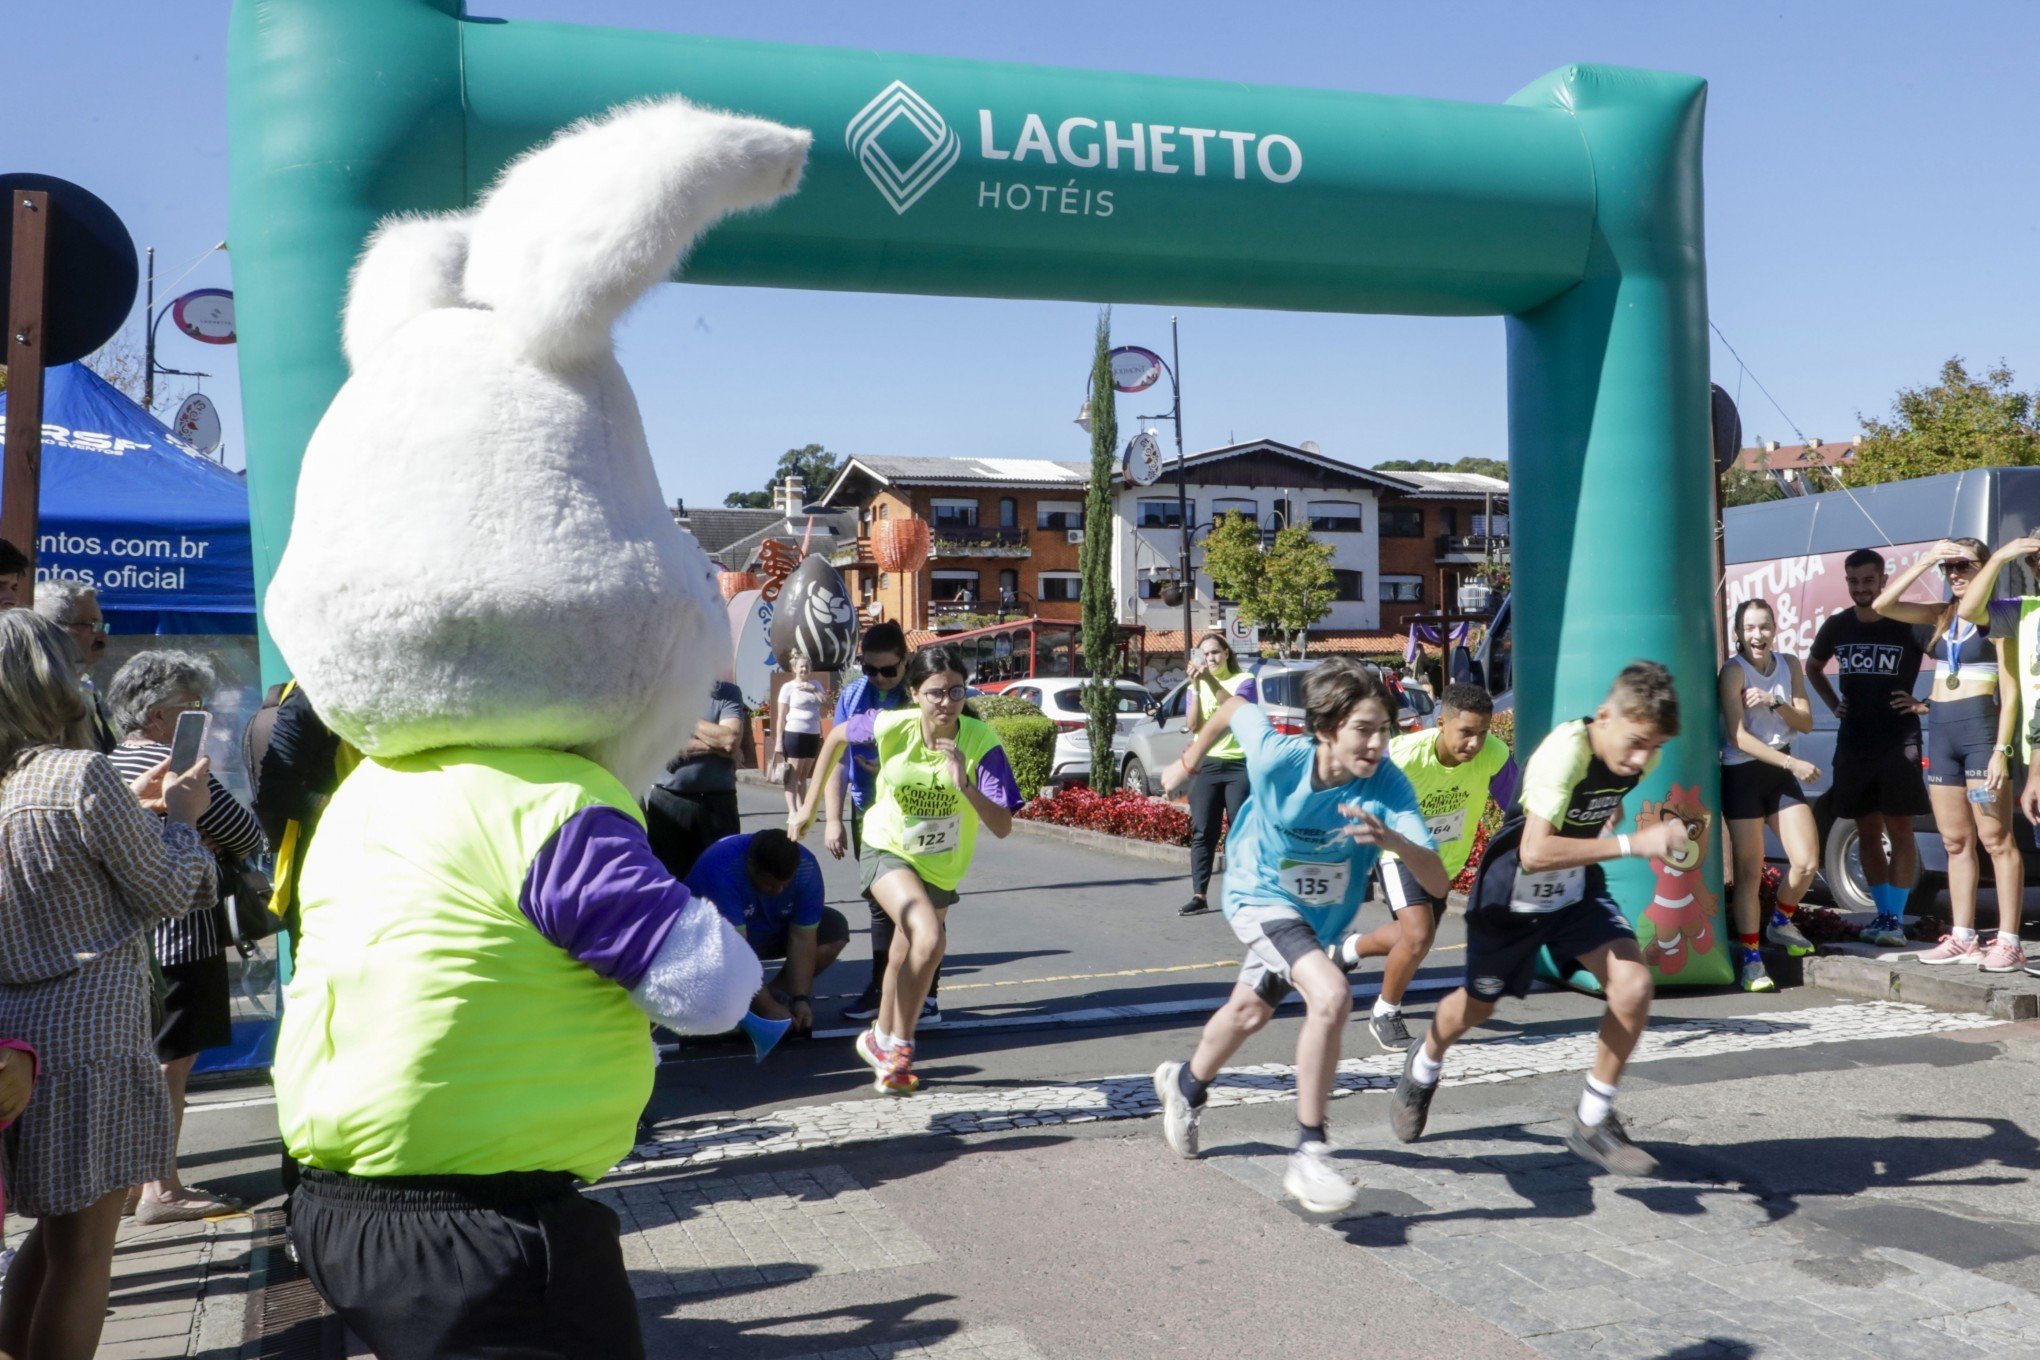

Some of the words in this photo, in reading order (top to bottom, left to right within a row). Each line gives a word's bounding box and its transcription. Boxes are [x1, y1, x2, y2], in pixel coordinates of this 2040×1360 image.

[978, 108, 1303, 184] LAGHETTO
[978, 178, 1115, 217] HOTÉIS
[58, 441, 124, 456] EVENTOS
[1776, 593, 1799, 629] &
[1237, 621, 1247, 635] E
[917, 831, 946, 847] 122
[1294, 877, 1330, 896] 135
[1532, 881, 1566, 898] 134
